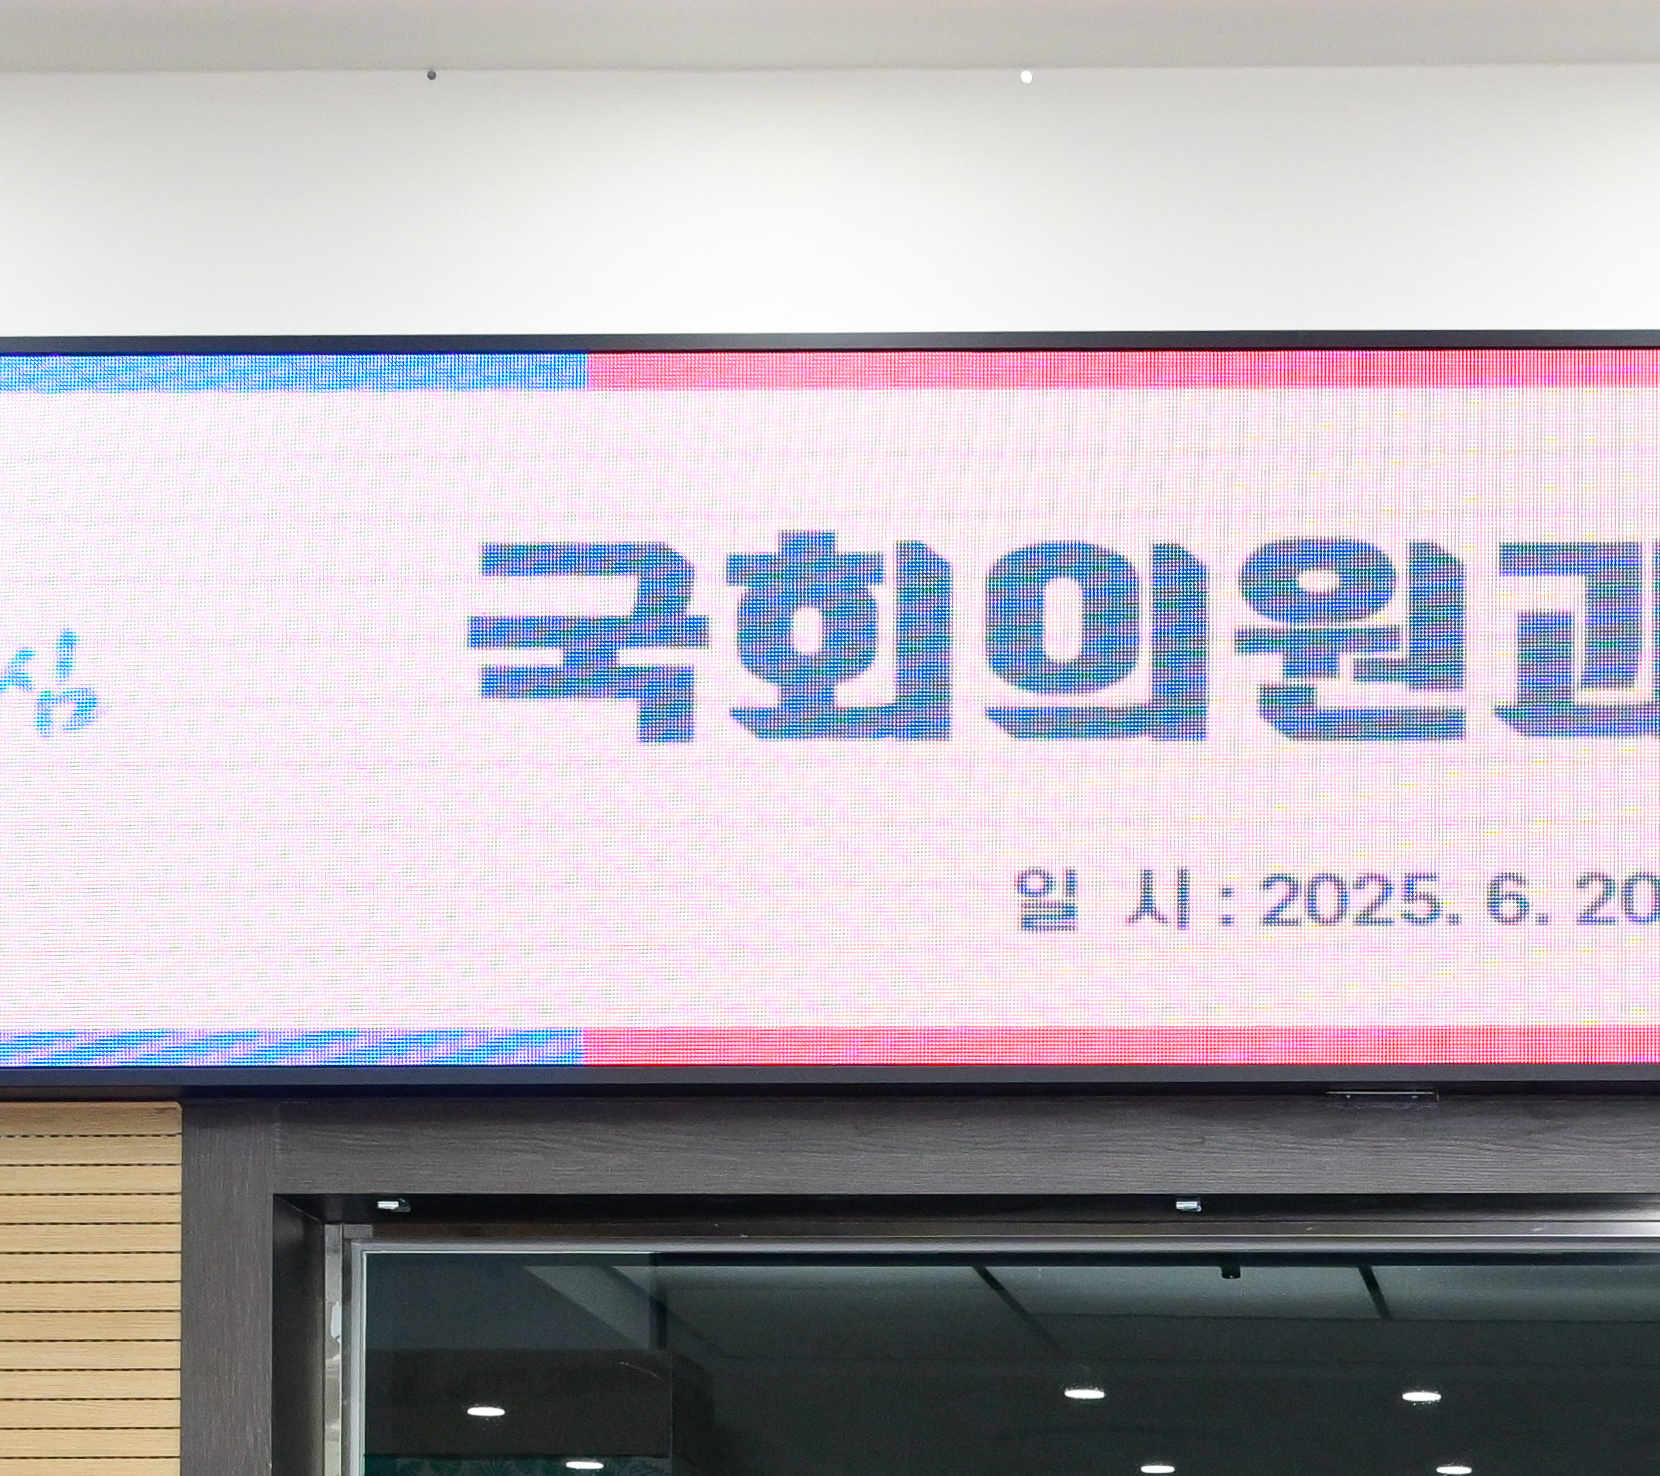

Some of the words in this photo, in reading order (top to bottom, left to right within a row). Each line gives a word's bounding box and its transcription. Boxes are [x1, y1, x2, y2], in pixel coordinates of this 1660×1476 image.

[1015, 868, 1078, 931] 일
[1258, 871, 1462, 928] 2025.
[1486, 871, 1551, 927] 6.
